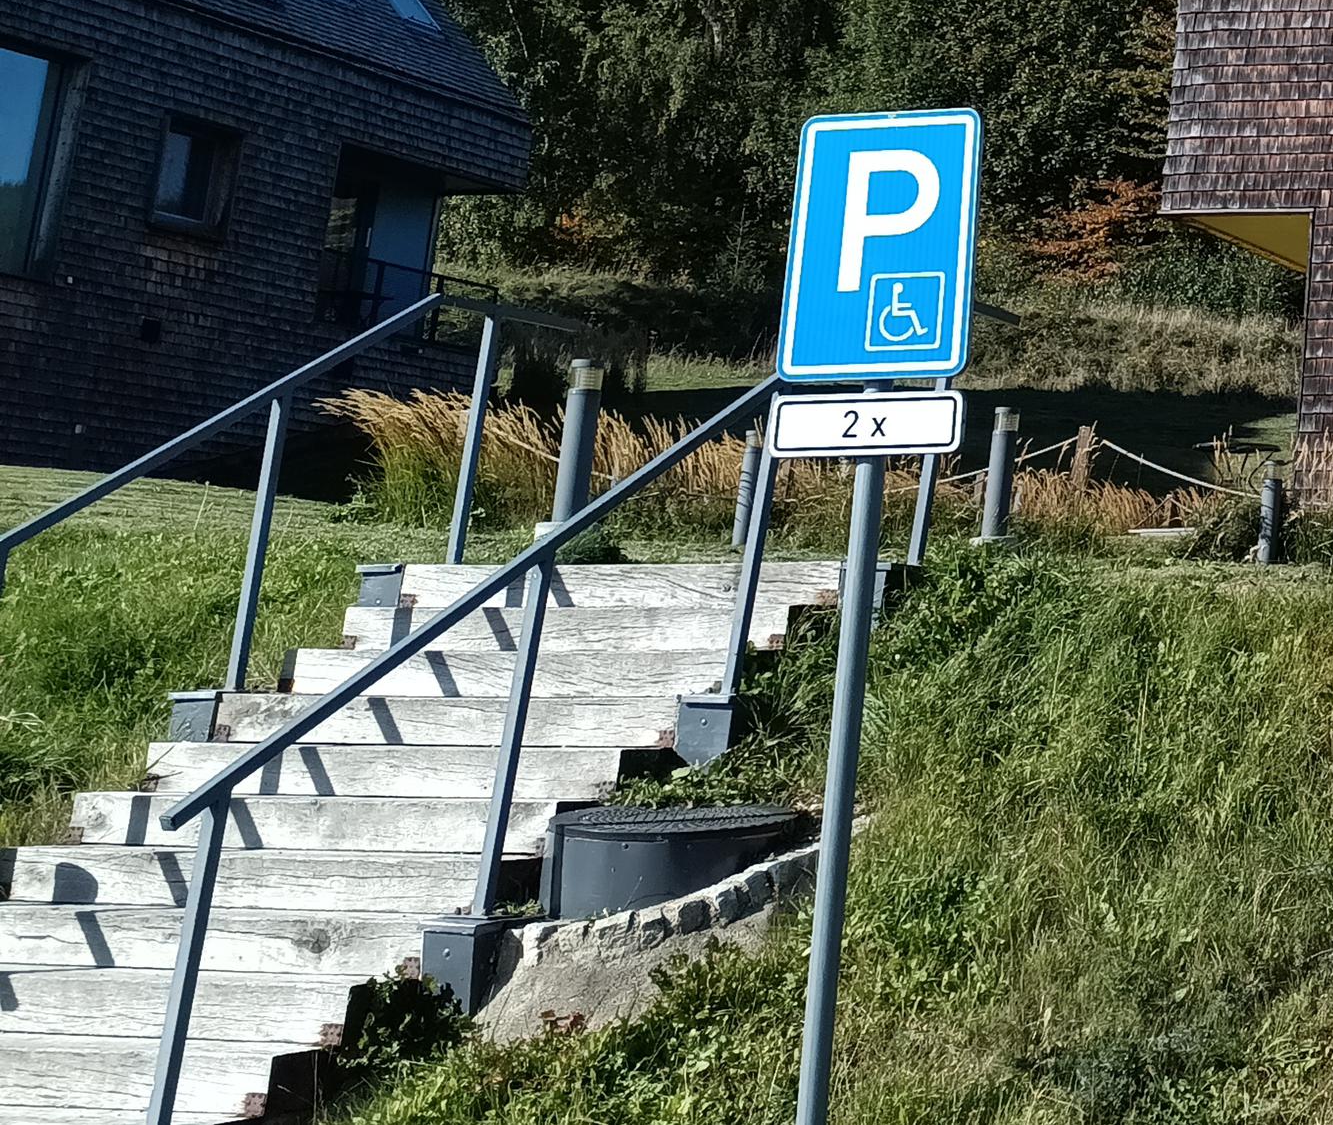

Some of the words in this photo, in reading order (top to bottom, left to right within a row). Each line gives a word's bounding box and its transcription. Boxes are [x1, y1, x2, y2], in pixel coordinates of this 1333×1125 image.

[837, 149, 940, 293] P
[842, 410, 859, 438] 2
[870, 416, 887, 437] x
